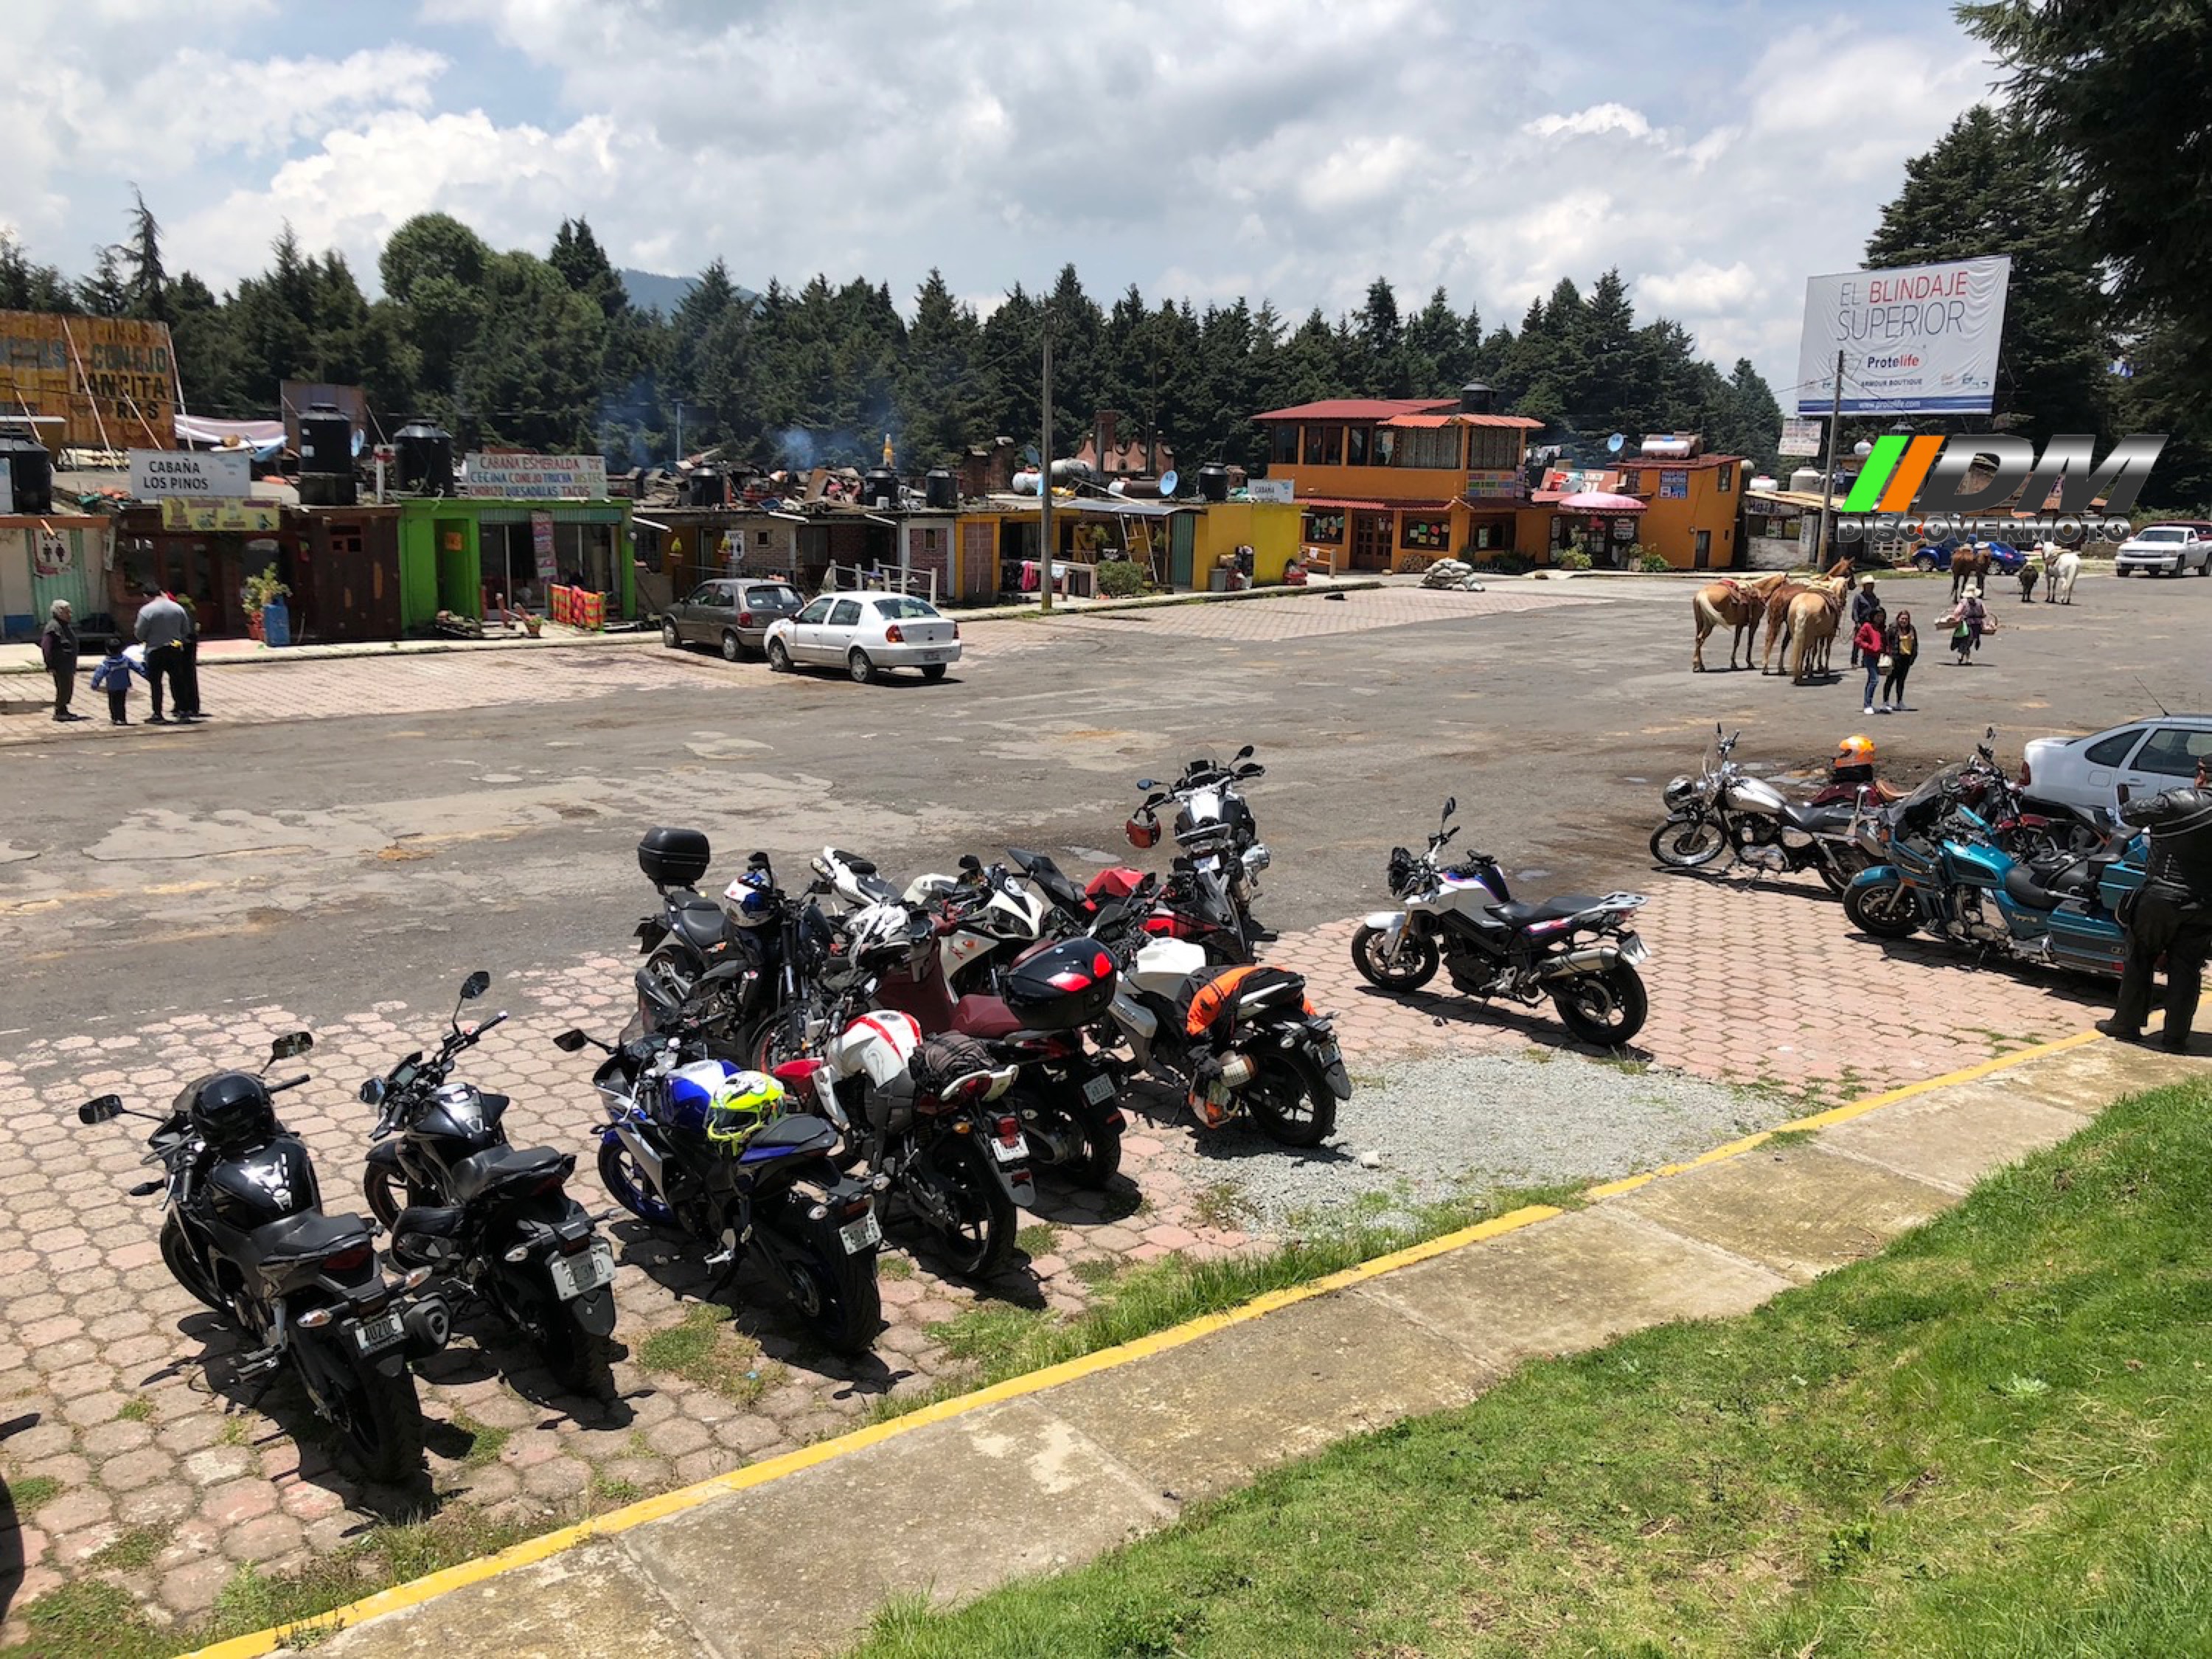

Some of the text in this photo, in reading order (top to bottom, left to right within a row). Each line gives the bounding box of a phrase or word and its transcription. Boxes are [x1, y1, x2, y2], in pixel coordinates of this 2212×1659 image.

[1840, 271, 1968, 306] EL BLINDAJE
[1837, 300, 1965, 341] SUPERIOR
[1868, 354, 1919, 369] Protelife
[149, 458, 201, 473] CABAÑA
[523, 457, 580, 470] ESMERALDA
[144, 477, 209, 490] LOS PINOS
[470, 471, 507, 483] CECINA
[560, 486, 591, 497] TACOS
